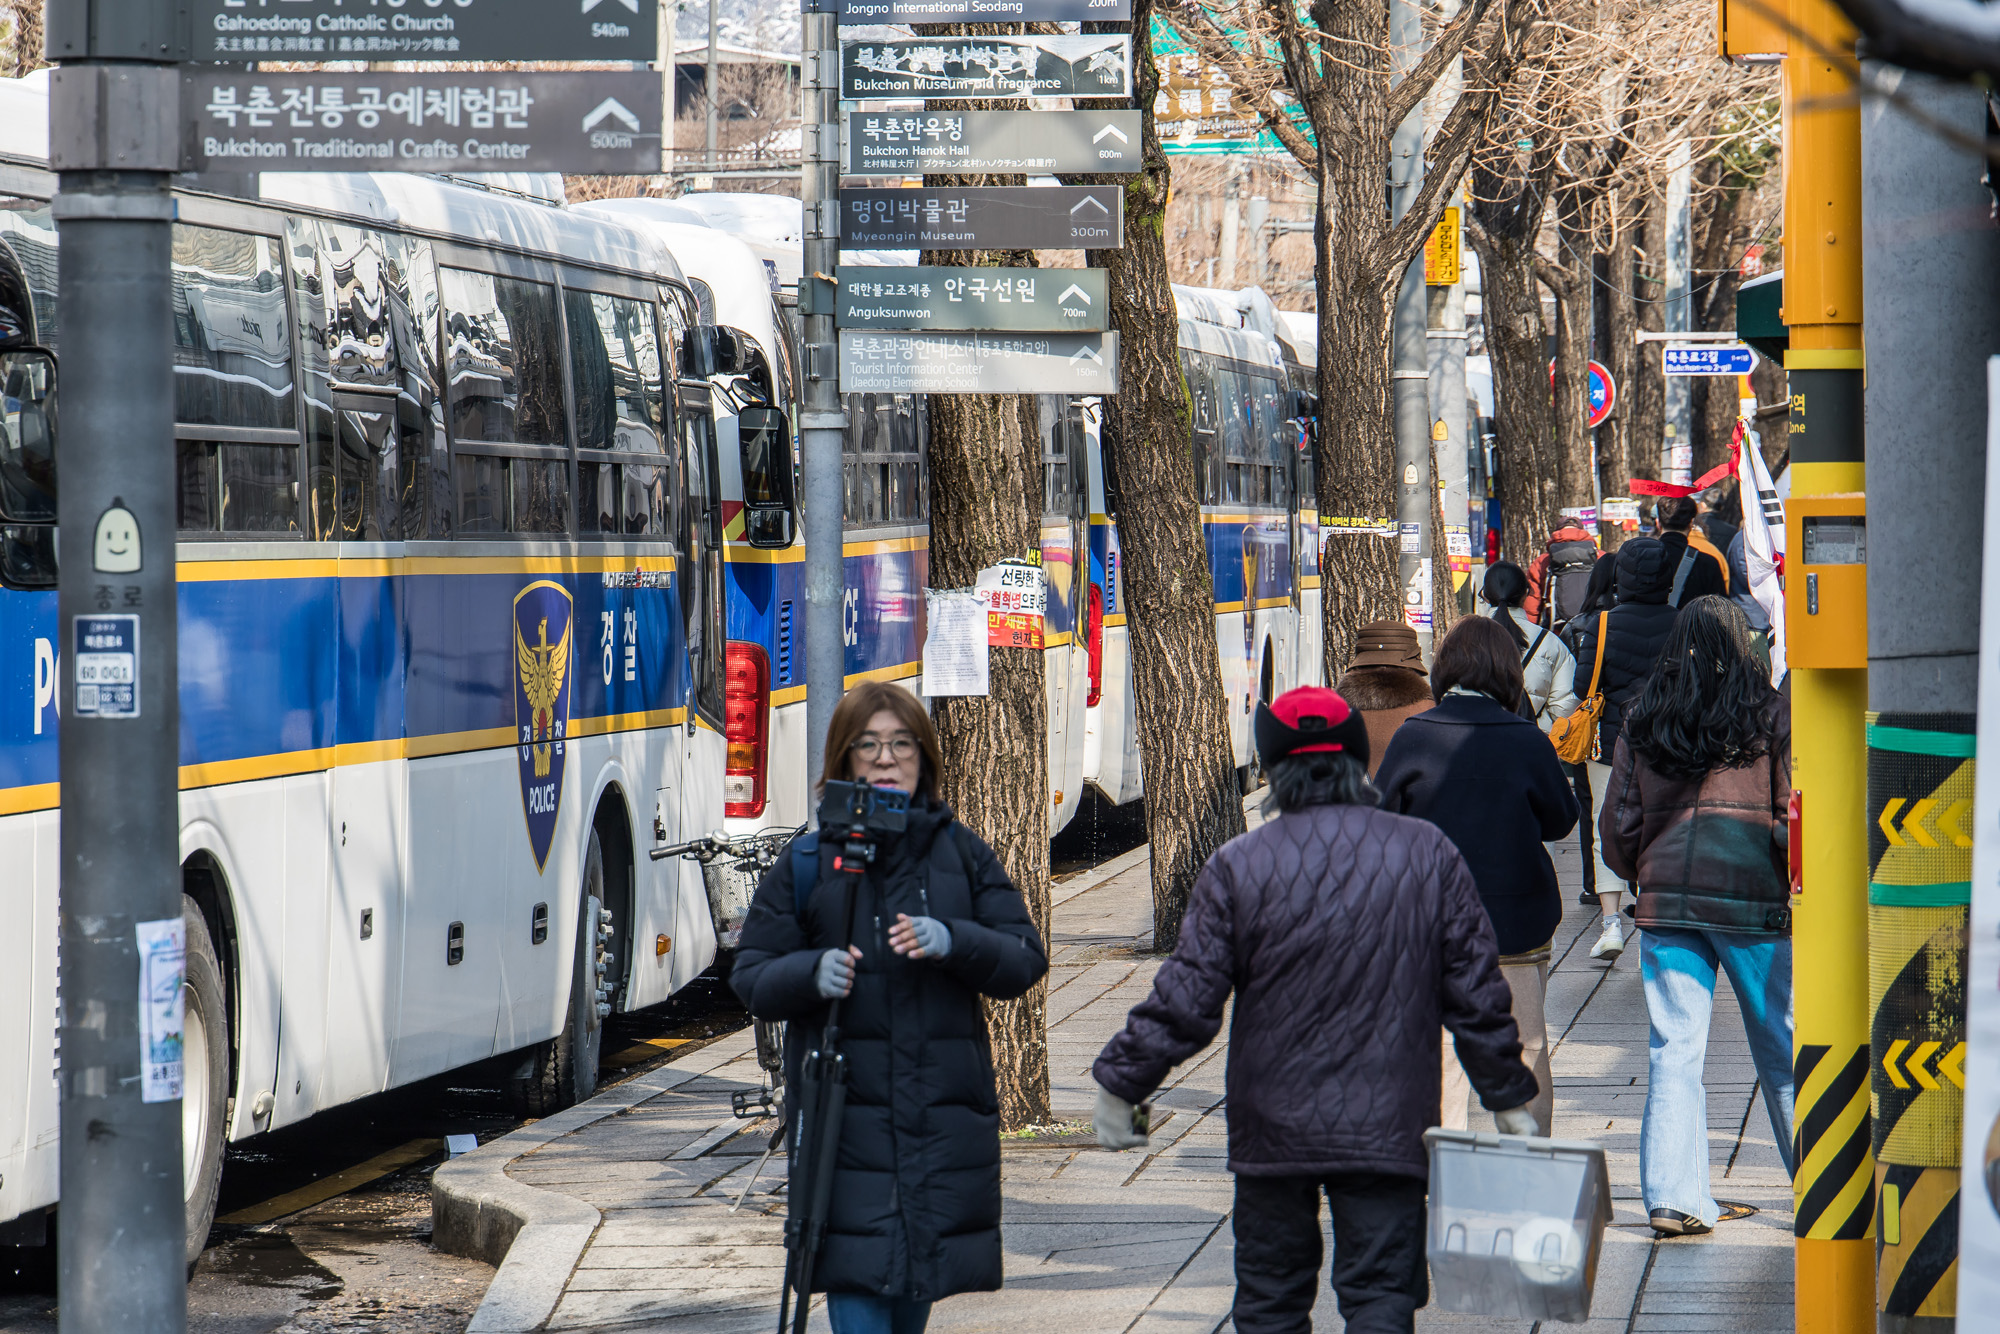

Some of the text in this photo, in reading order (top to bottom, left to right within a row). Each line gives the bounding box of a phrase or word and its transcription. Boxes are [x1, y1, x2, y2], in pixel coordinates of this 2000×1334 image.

[845, 0, 1023, 16] Jongno International Seodang
[213, 13, 454, 34] Gahoedong Catholic Church
[591, 22, 629, 38] 540m
[854, 78, 910, 91] Bukchon
[998, 78, 1061, 92] fragrance
[1099, 74, 1119, 84] 1km
[205, 85, 535, 129] 북촌전통공예체험관
[862, 117, 962, 141] 북촌한옥청
[204, 136, 531, 159] Bukchon Traditional Crafts Center
[590, 134, 632, 149] 500m
[863, 145, 969, 156] Bukchon Hanok Hall
[1099, 150, 1122, 159] 600m
[851, 198, 969, 224] 명인박물관
[851, 230, 975, 242] Myeongin Museum
[1070, 227, 1109, 238] 300m
[848, 277, 1035, 303] 대한불교조계종 안국선원
[848, 305, 931, 321] Anguksunwon
[1062, 307, 1086, 318] 700m
[850, 362, 984, 375] Tourist Information Center
[1076, 368, 1098, 377] 150m
[850, 376, 979, 389] (Jaedong Elementary School)
[1001, 568, 1034, 588] 선량한
[94, 584, 143, 611] 종로
[529, 784, 555, 814] POLICE
